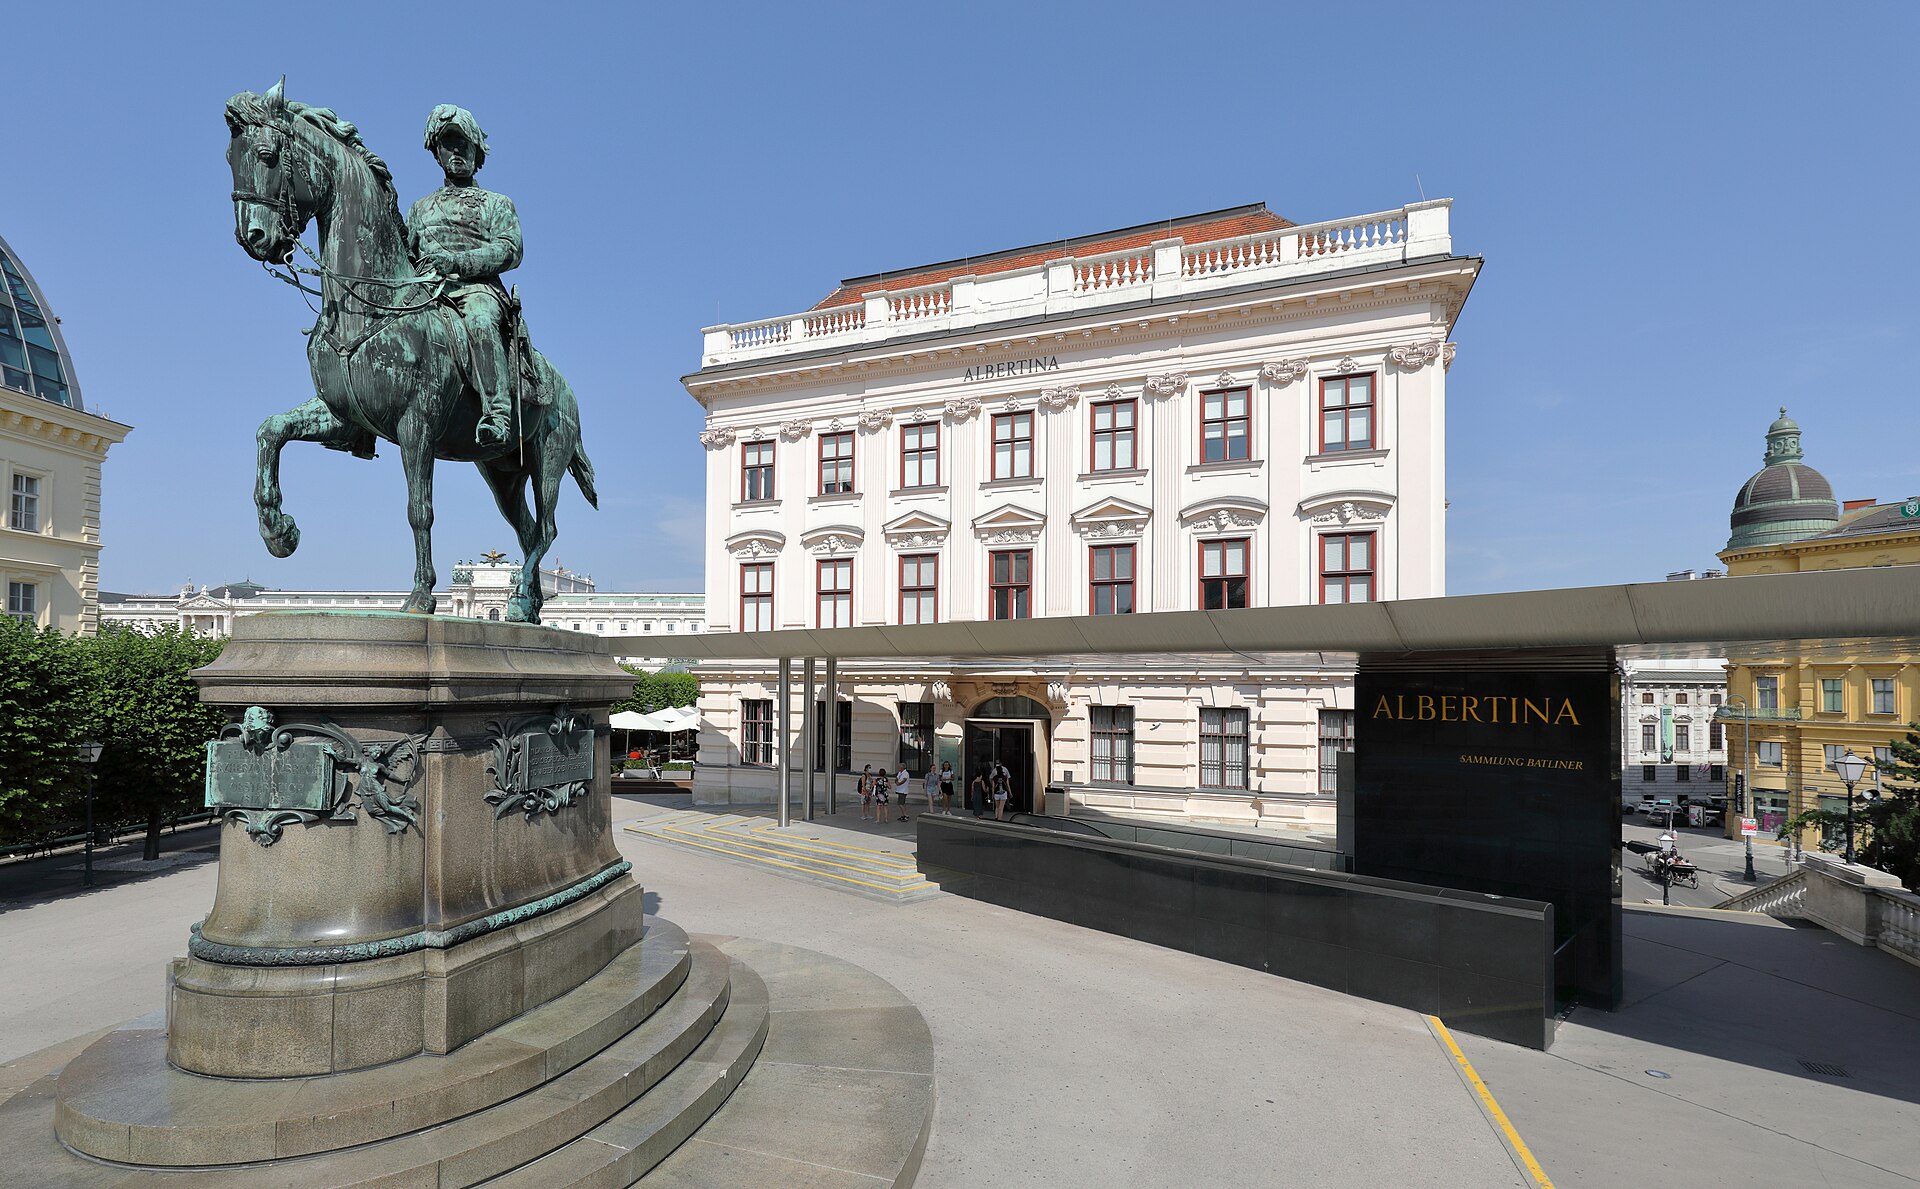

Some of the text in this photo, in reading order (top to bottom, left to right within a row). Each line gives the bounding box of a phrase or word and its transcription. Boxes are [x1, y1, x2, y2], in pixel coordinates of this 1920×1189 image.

[963, 355, 1060, 382] ALBERTINA
[1372, 694, 1582, 726] ALBERTINA
[1460, 754, 1584, 771] SAMMLUNG BATLINER
